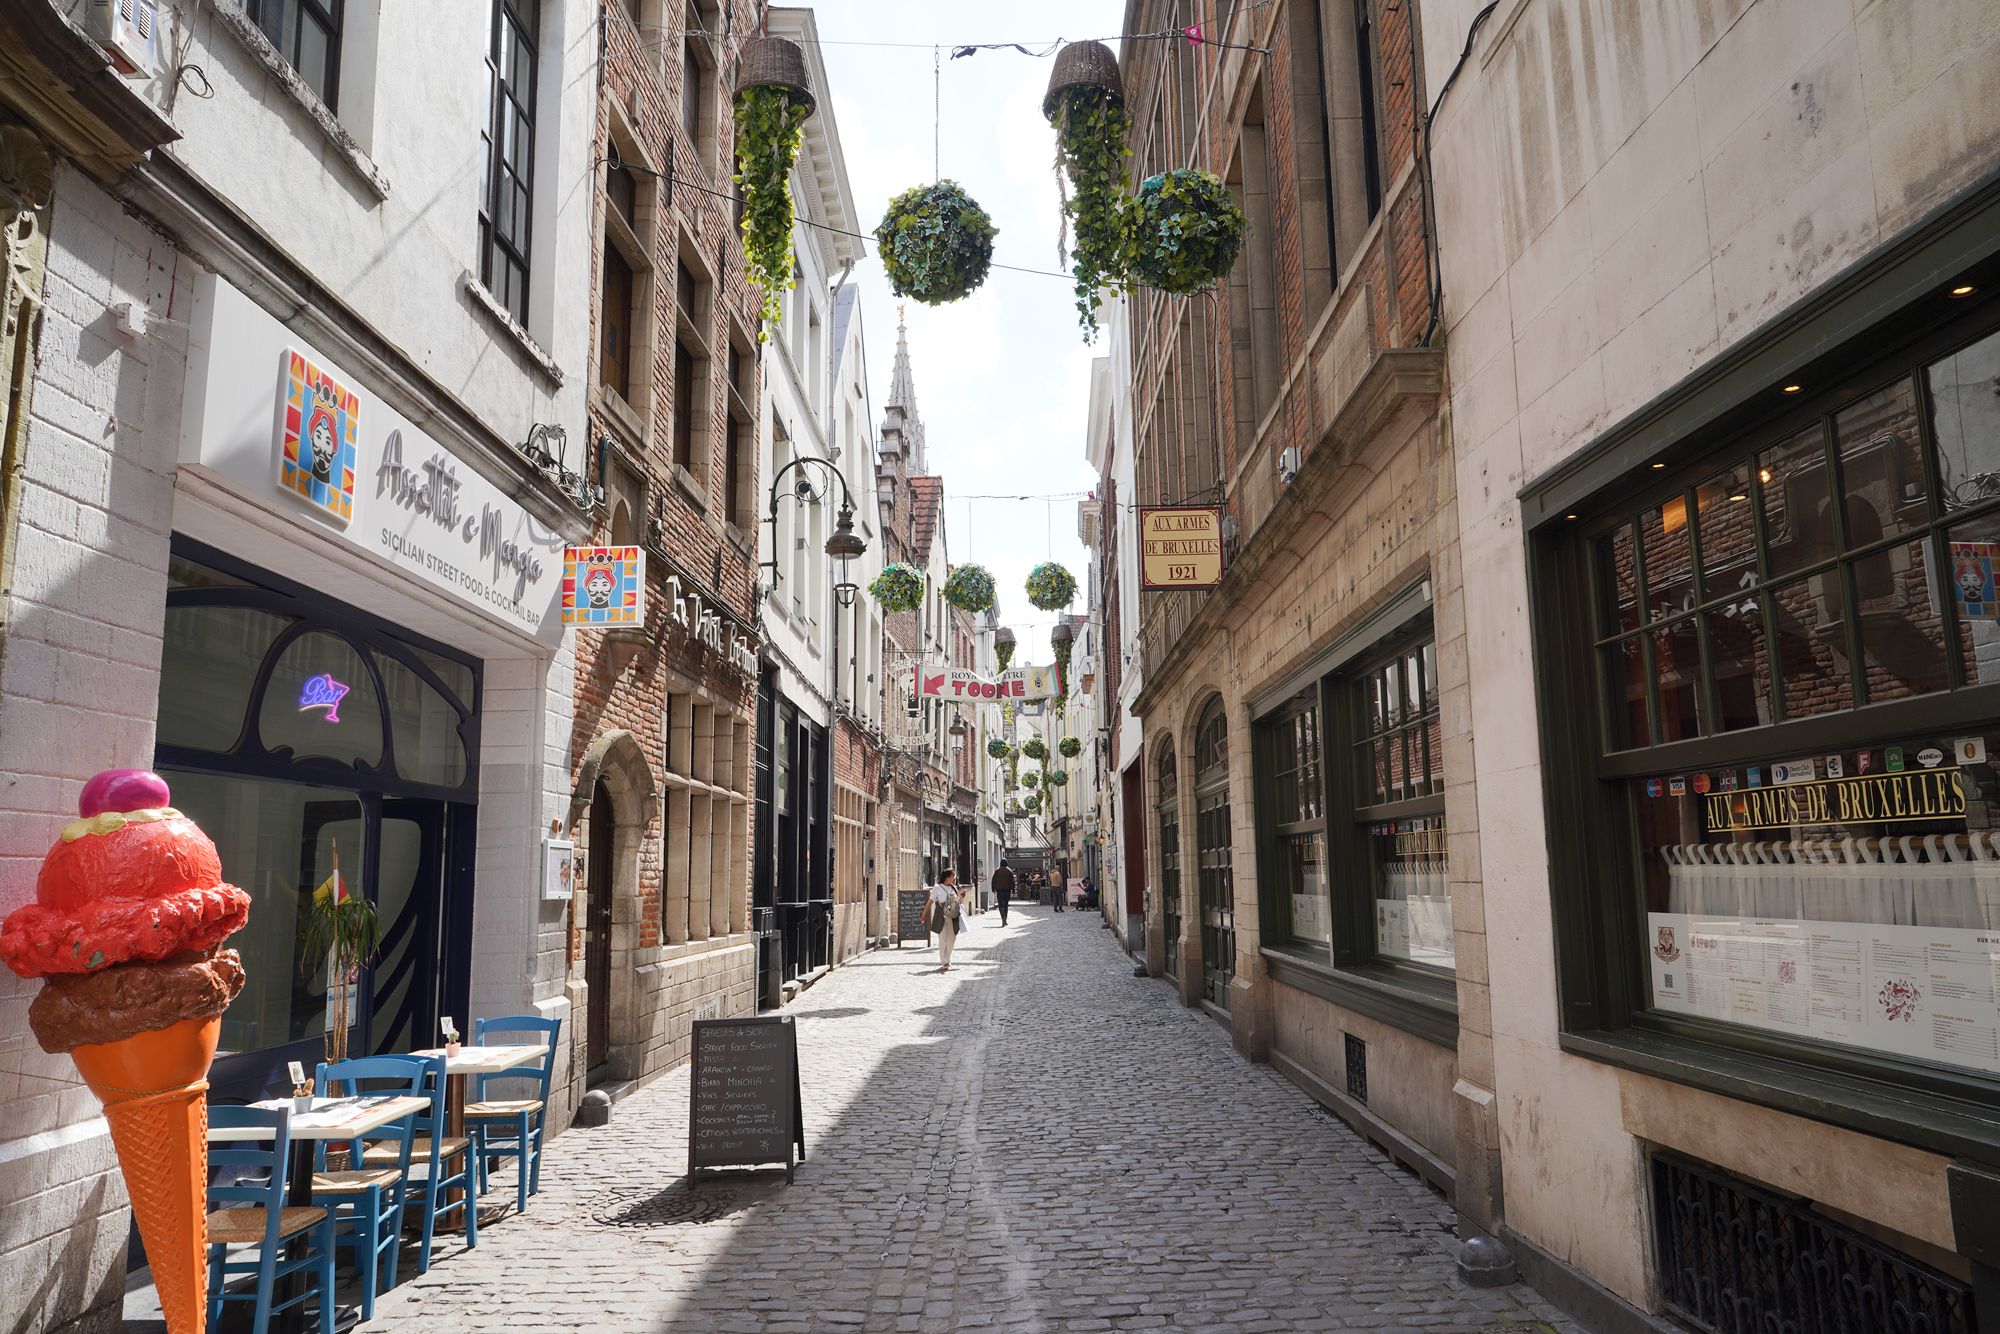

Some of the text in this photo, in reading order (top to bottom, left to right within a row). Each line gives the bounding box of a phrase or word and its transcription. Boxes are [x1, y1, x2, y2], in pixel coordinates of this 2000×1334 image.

[1153, 516, 1210, 530] AUX ARMES
[481, 502, 543, 603] Mangia
[1145, 540, 1219, 554] DE BRUXELLES
[381, 528, 540, 627] SICILIAN STREET FOOD & COCKTAIL BAR
[1168, 566, 1197, 579] 1921
[951, 671, 977, 680] ROYA
[302, 676, 344, 705] Bar
[951, 680, 1026, 699] TOONE
[1720, 776, 1737, 786] JCB
[1707, 770, 1967, 829] AUX ARMES DE BRUXELLES
